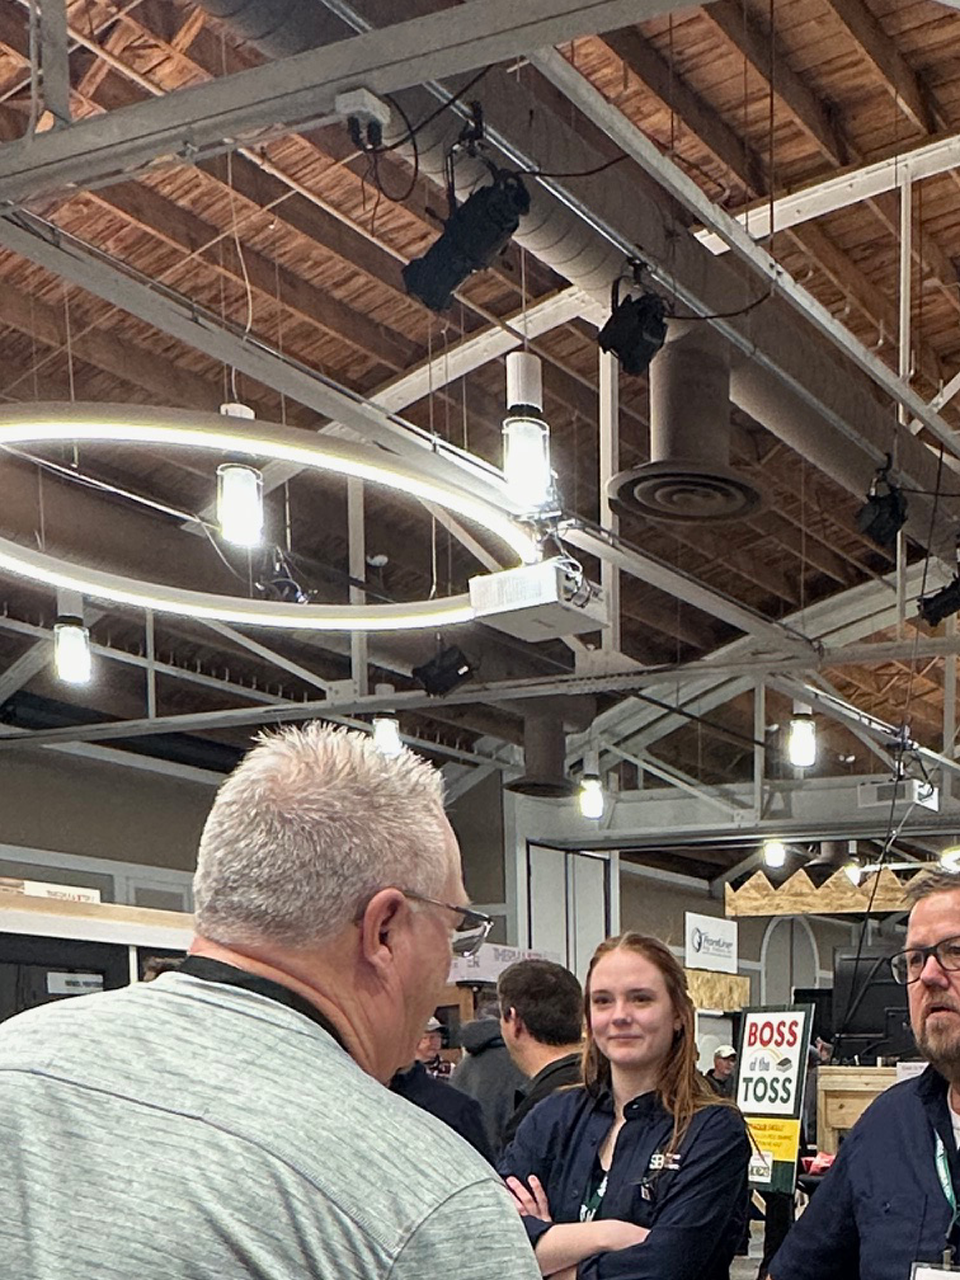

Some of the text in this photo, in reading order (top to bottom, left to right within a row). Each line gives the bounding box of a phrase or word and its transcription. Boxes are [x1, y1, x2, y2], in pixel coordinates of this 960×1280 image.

[748, 1020, 799, 1047] BOSS
[758, 1057, 771, 1072] the
[742, 1076, 792, 1104] TOSS
